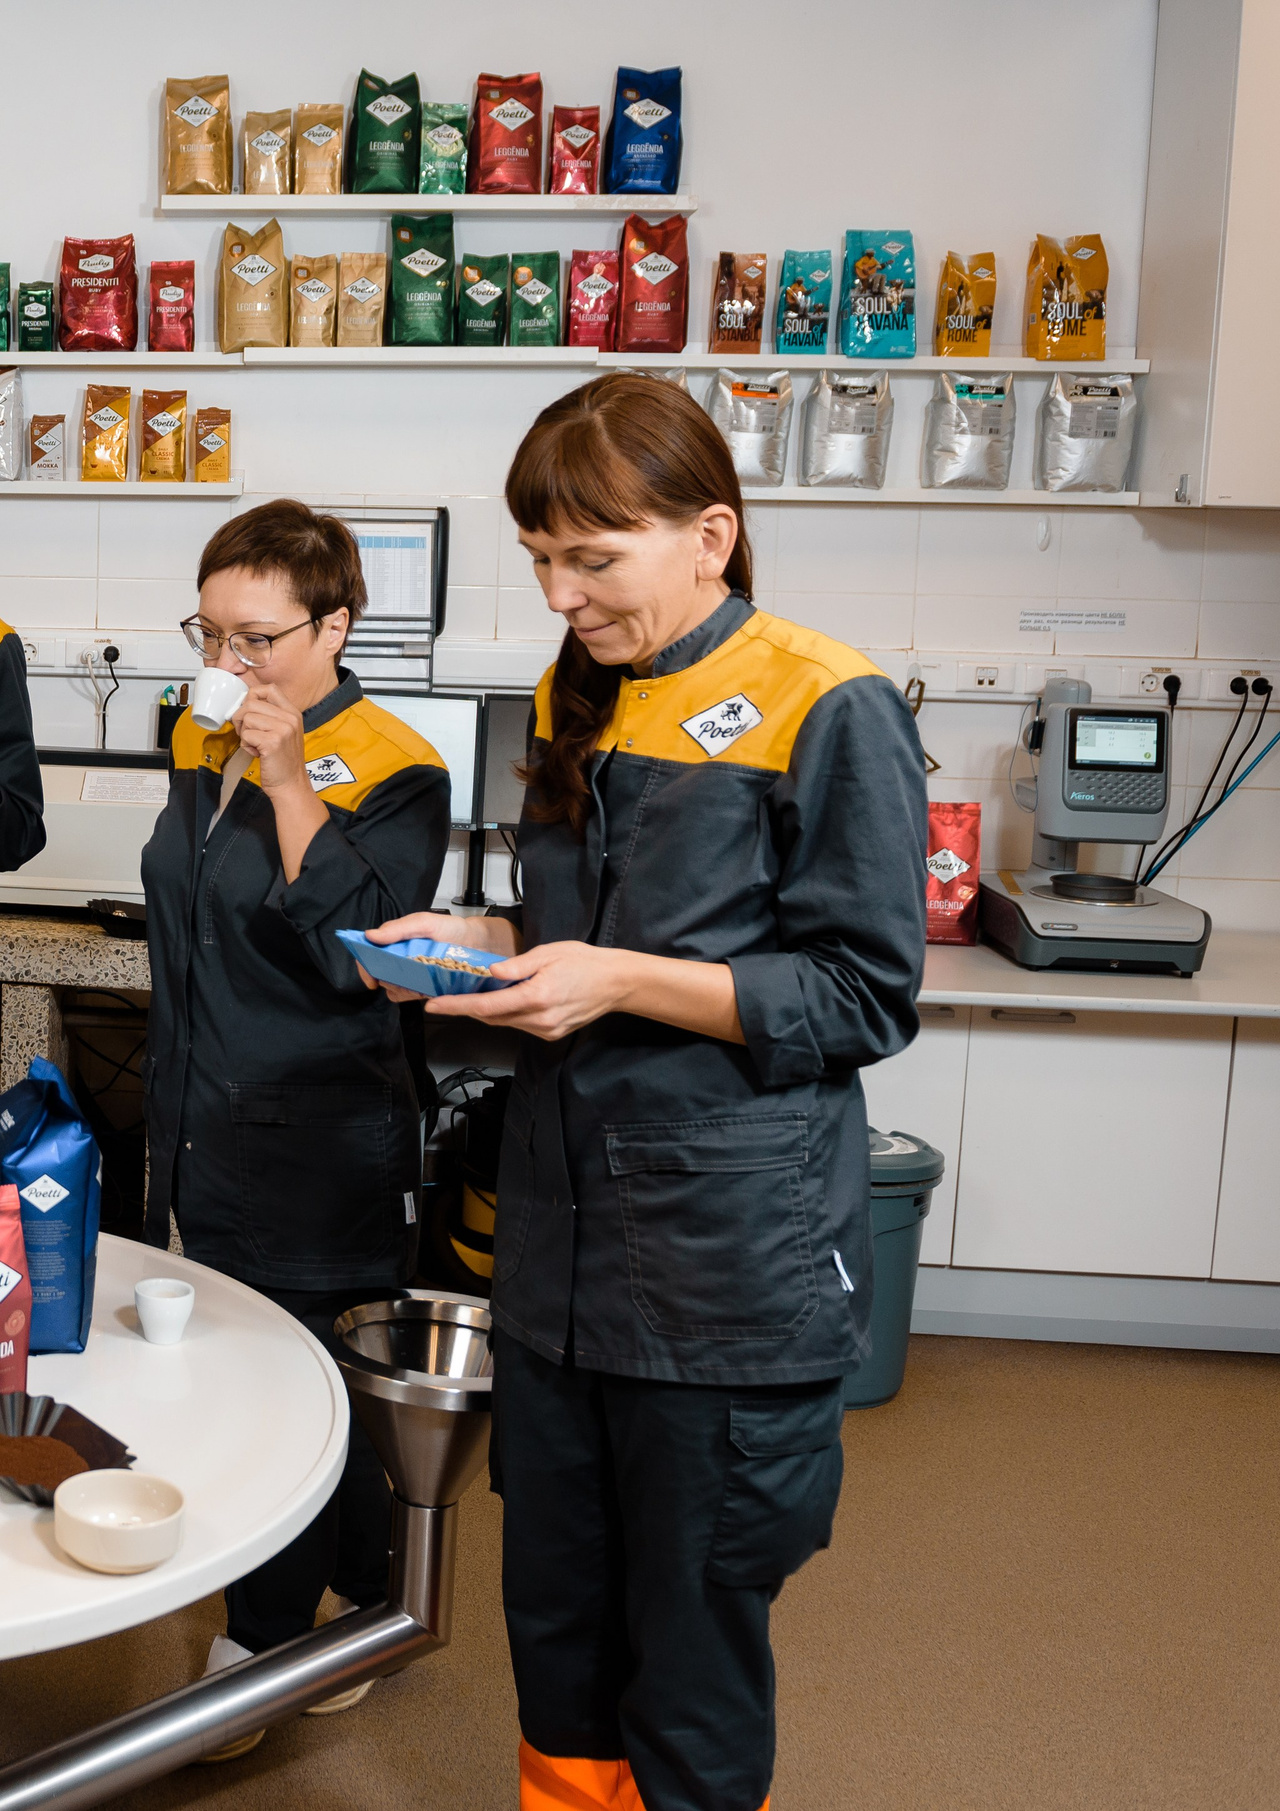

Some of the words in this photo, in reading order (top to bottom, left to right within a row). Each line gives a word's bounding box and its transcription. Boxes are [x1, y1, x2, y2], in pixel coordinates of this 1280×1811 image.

[180, 105, 212, 116] Poetti
[372, 102, 406, 114] Poetti
[630, 105, 665, 116] Poetti
[496, 108, 528, 120] Poetti
[307, 129, 333, 139] Poetti
[432, 131, 458, 141] Poetti
[564, 130, 590, 140] Poetti
[255, 138, 281, 148] Poetti
[407, 257, 440, 266] Poetti
[238, 264, 269, 274] Poetti
[638, 262, 672, 272] Poetti
[71, 277, 119, 288] PRESIDENTTI
[582, 281, 608, 290] Poetti
[300, 284, 326, 294] Poetti
[521, 286, 547, 296] Poetti
[857, 297, 891, 314] SOUL
[892, 301, 906, 313] of
[1047, 301, 1083, 320] SOUL
[1084, 308, 1098, 320] of
[720, 314, 746, 328] SOUL
[784, 318, 812, 333] SOUL
[812, 322, 824, 333] of
[856, 314, 908, 331] HAVANA
[947, 314, 976, 330] SOUL
[976, 319, 988, 330] of
[717, 329, 760, 342] ISTANBUL
[784, 333, 824, 346] HAVANA
[946, 329, 978, 343] ROME
[1087, 386, 1112, 395] Poetti
[93, 413, 119, 422] Poetti
[151, 418, 176, 428] Poetti
[1070, 791, 1095, 801] Aeros
[27, 1188, 61, 1198] Poetti
